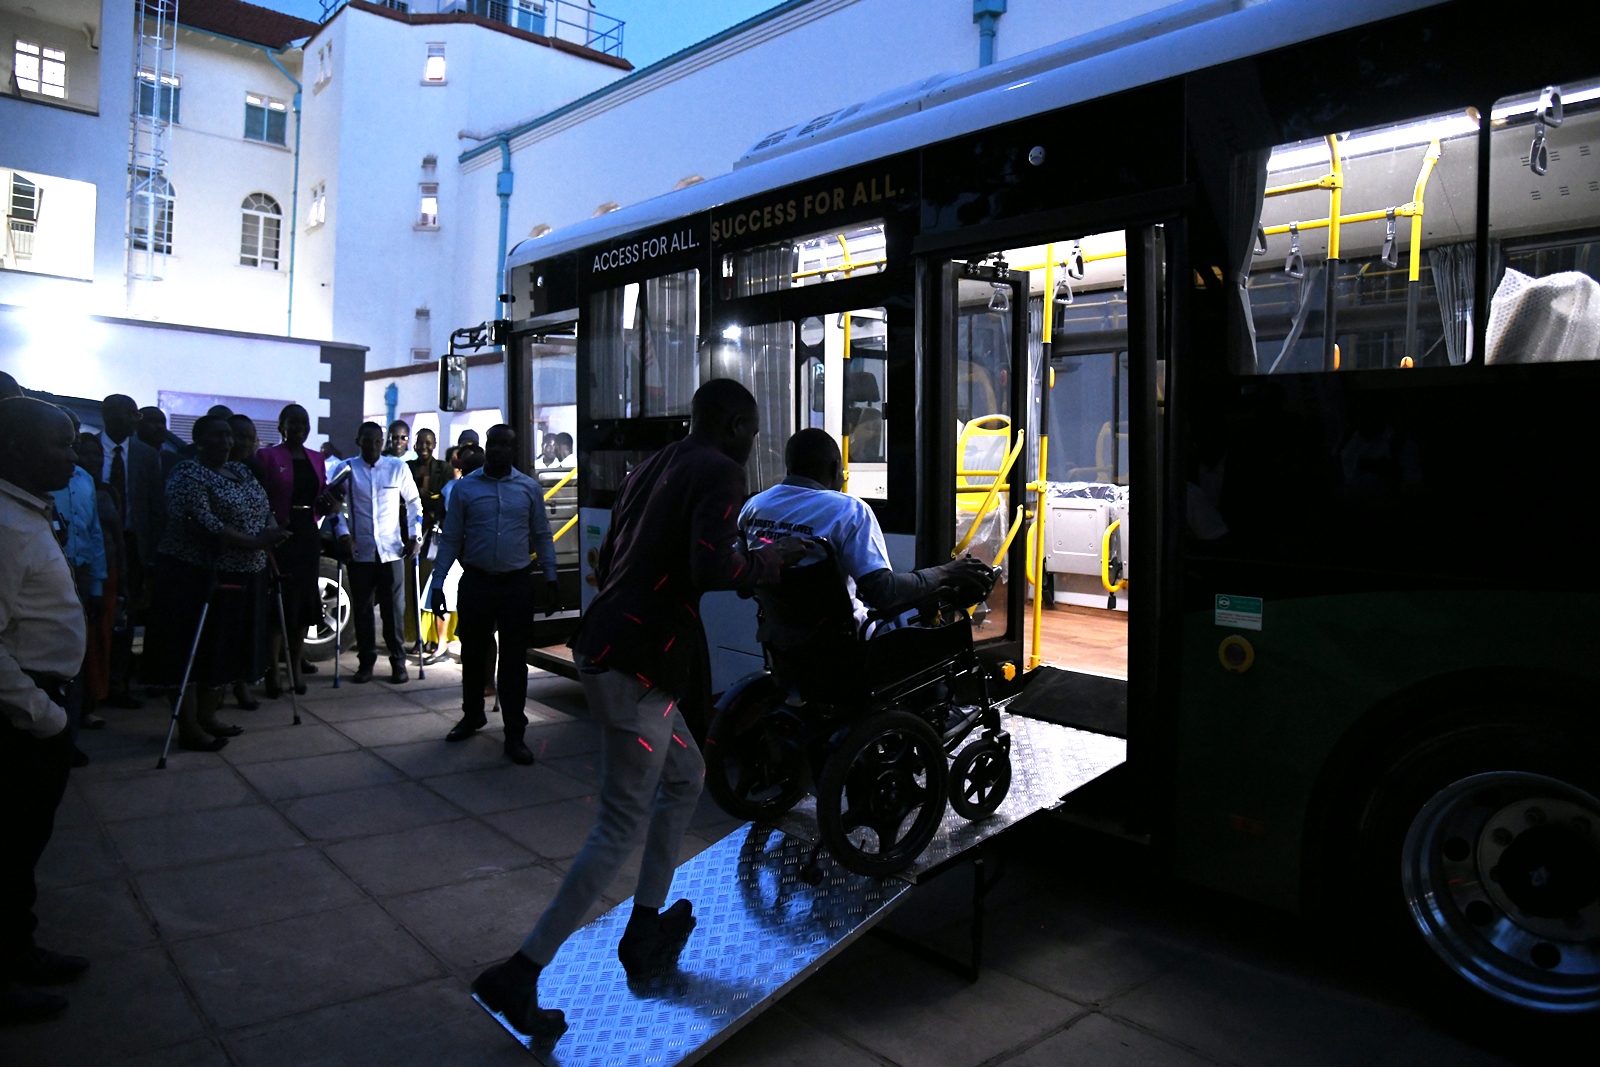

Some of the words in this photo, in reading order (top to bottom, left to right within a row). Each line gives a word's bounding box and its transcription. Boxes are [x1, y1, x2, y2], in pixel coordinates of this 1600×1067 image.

[711, 200, 797, 242] SUCCESS
[803, 187, 845, 219] FOR
[852, 174, 905, 206] ALL.
[592, 243, 639, 273] ACCESS
[642, 236, 667, 260] FOR
[670, 229, 700, 253] ALL.
